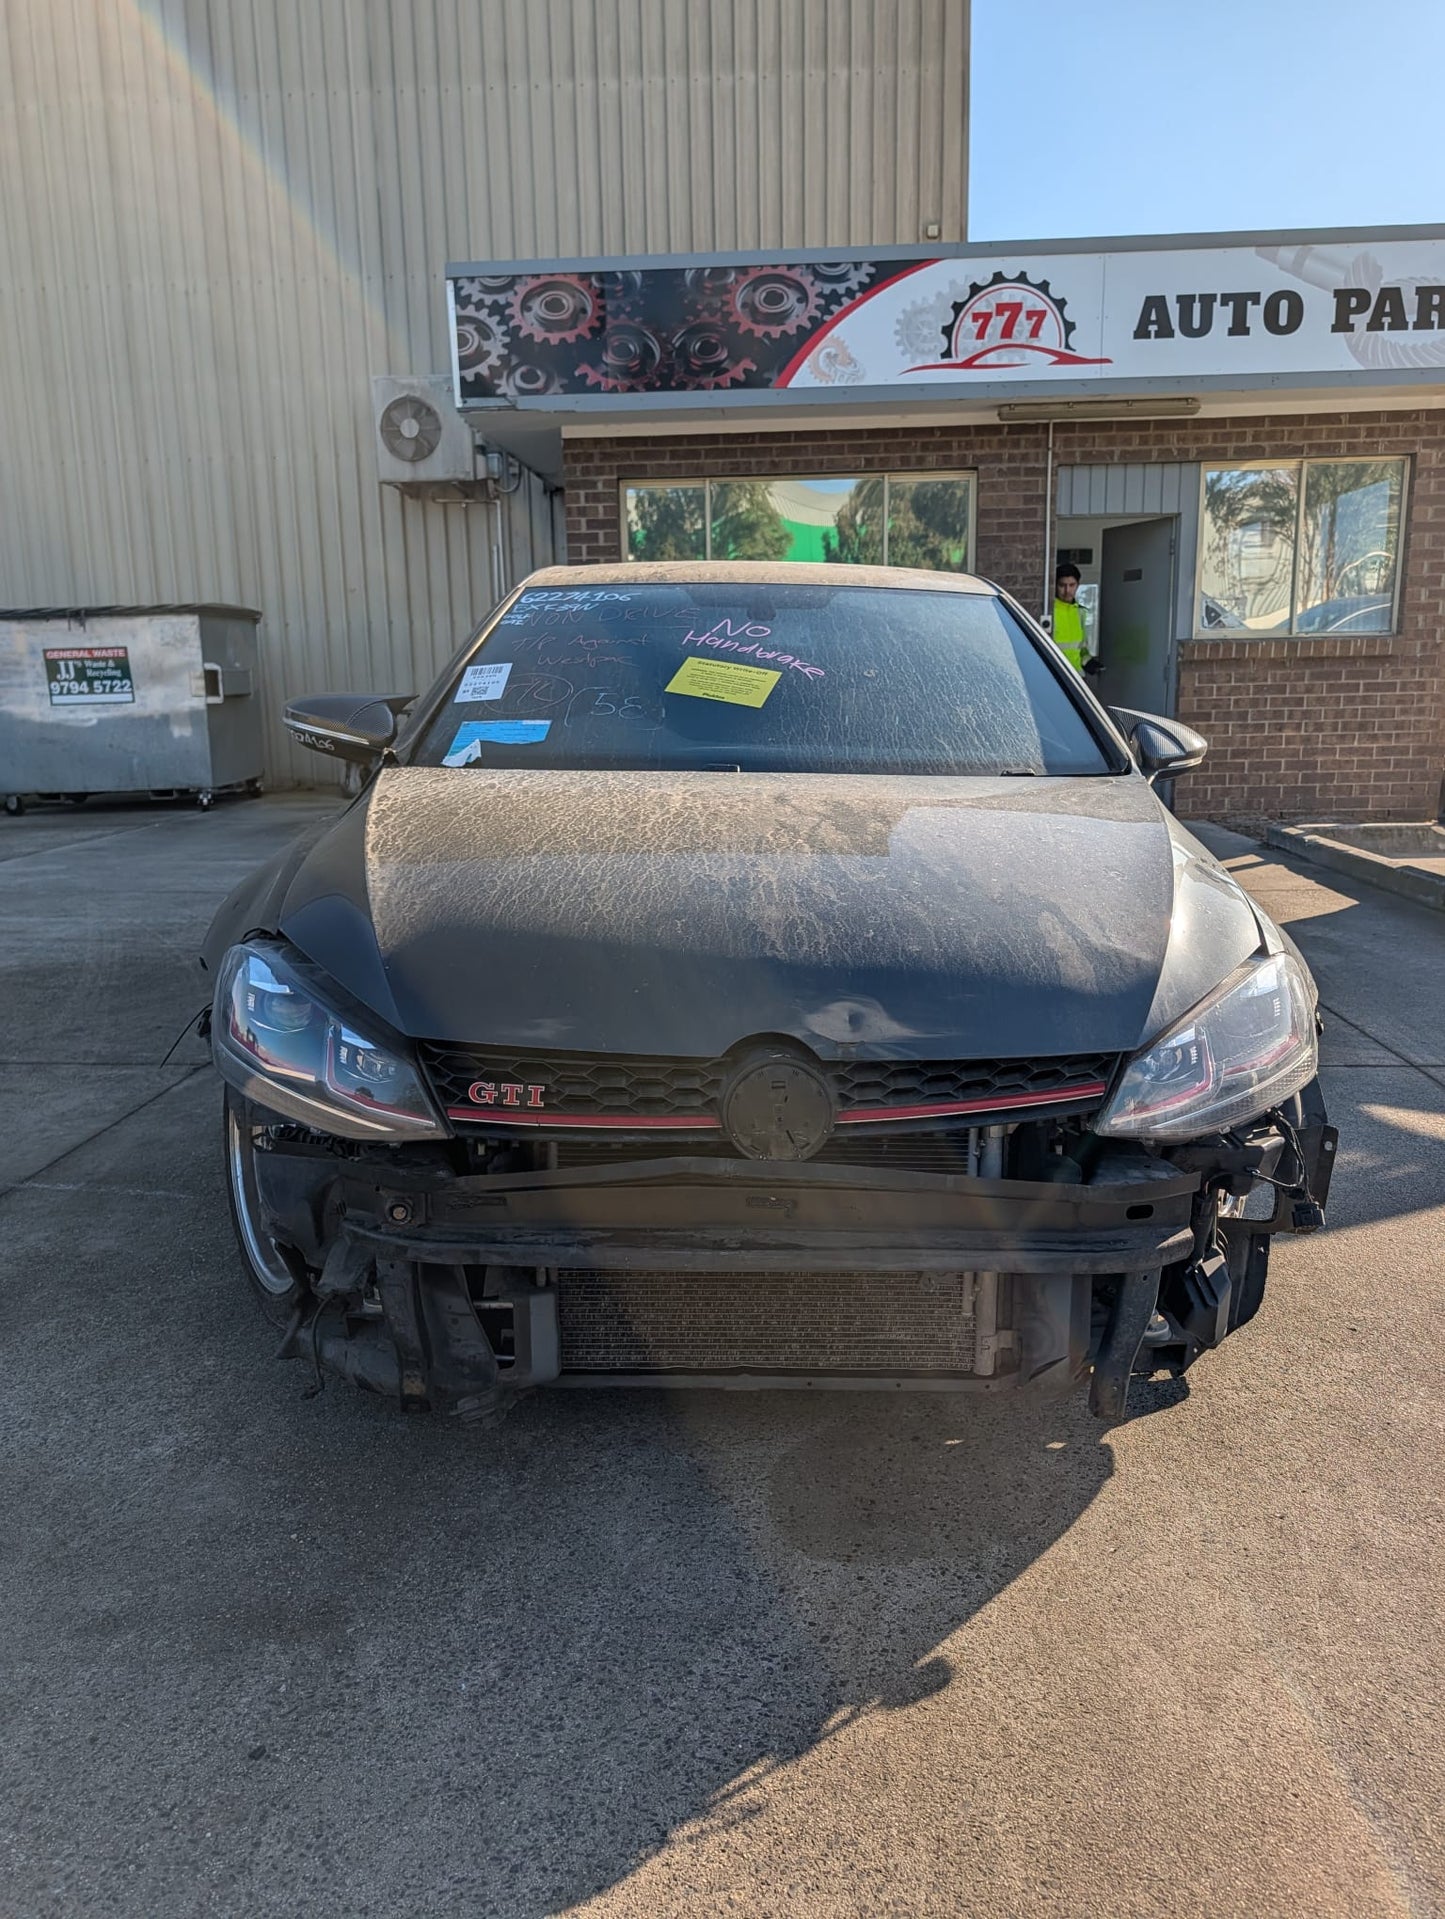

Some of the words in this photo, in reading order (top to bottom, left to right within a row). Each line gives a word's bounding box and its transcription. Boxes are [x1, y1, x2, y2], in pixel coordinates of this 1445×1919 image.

[972, 302, 1047, 340] 777
[1133, 290, 1304, 339] AUTO
[1331, 286, 1445, 333] PAR
[46, 650, 94, 659] GENERAL
[94, 649, 125, 657] WASTE
[84, 660, 106, 668] Waste
[682, 630, 825, 681] Handbrake
[86, 668, 122, 678] Recycling
[50, 681, 89, 694] 9794
[93, 680, 132, 693] 5722
[468, 1081, 545, 1107] GTI
